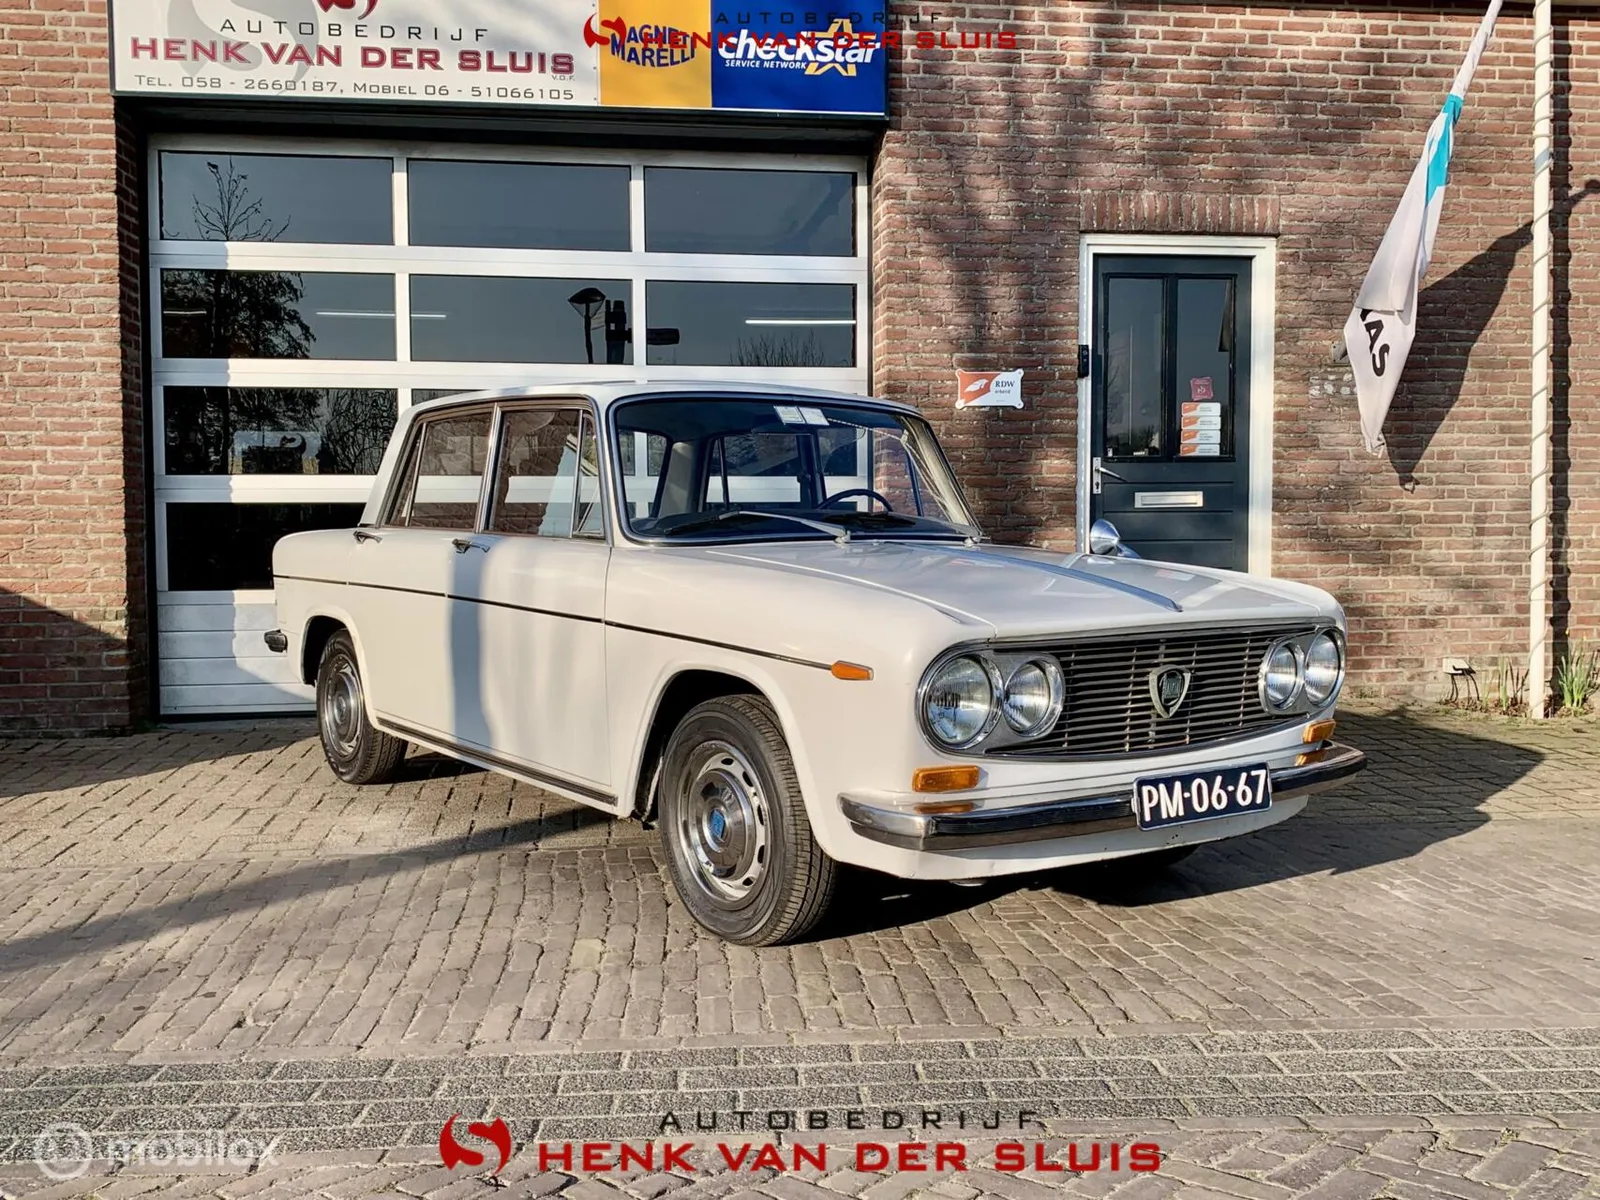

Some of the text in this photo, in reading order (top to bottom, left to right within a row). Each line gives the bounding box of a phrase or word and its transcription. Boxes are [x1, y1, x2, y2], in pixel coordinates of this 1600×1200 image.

[220, 18, 489, 43] AUTOBEDRIJF
[130, 37, 575, 75] HENK VAN DER SLUIS
[725, 59, 807, 69] SERVICE NETWORK
[182, 76, 222, 89] 058
[244, 79, 344, 94] 2660187,
[424, 85, 449, 96] 06
[471, 86, 574, 100] 51066105
[995, 380, 1014, 388] RDW
[1141, 769, 1267, 822] PM-06-67
